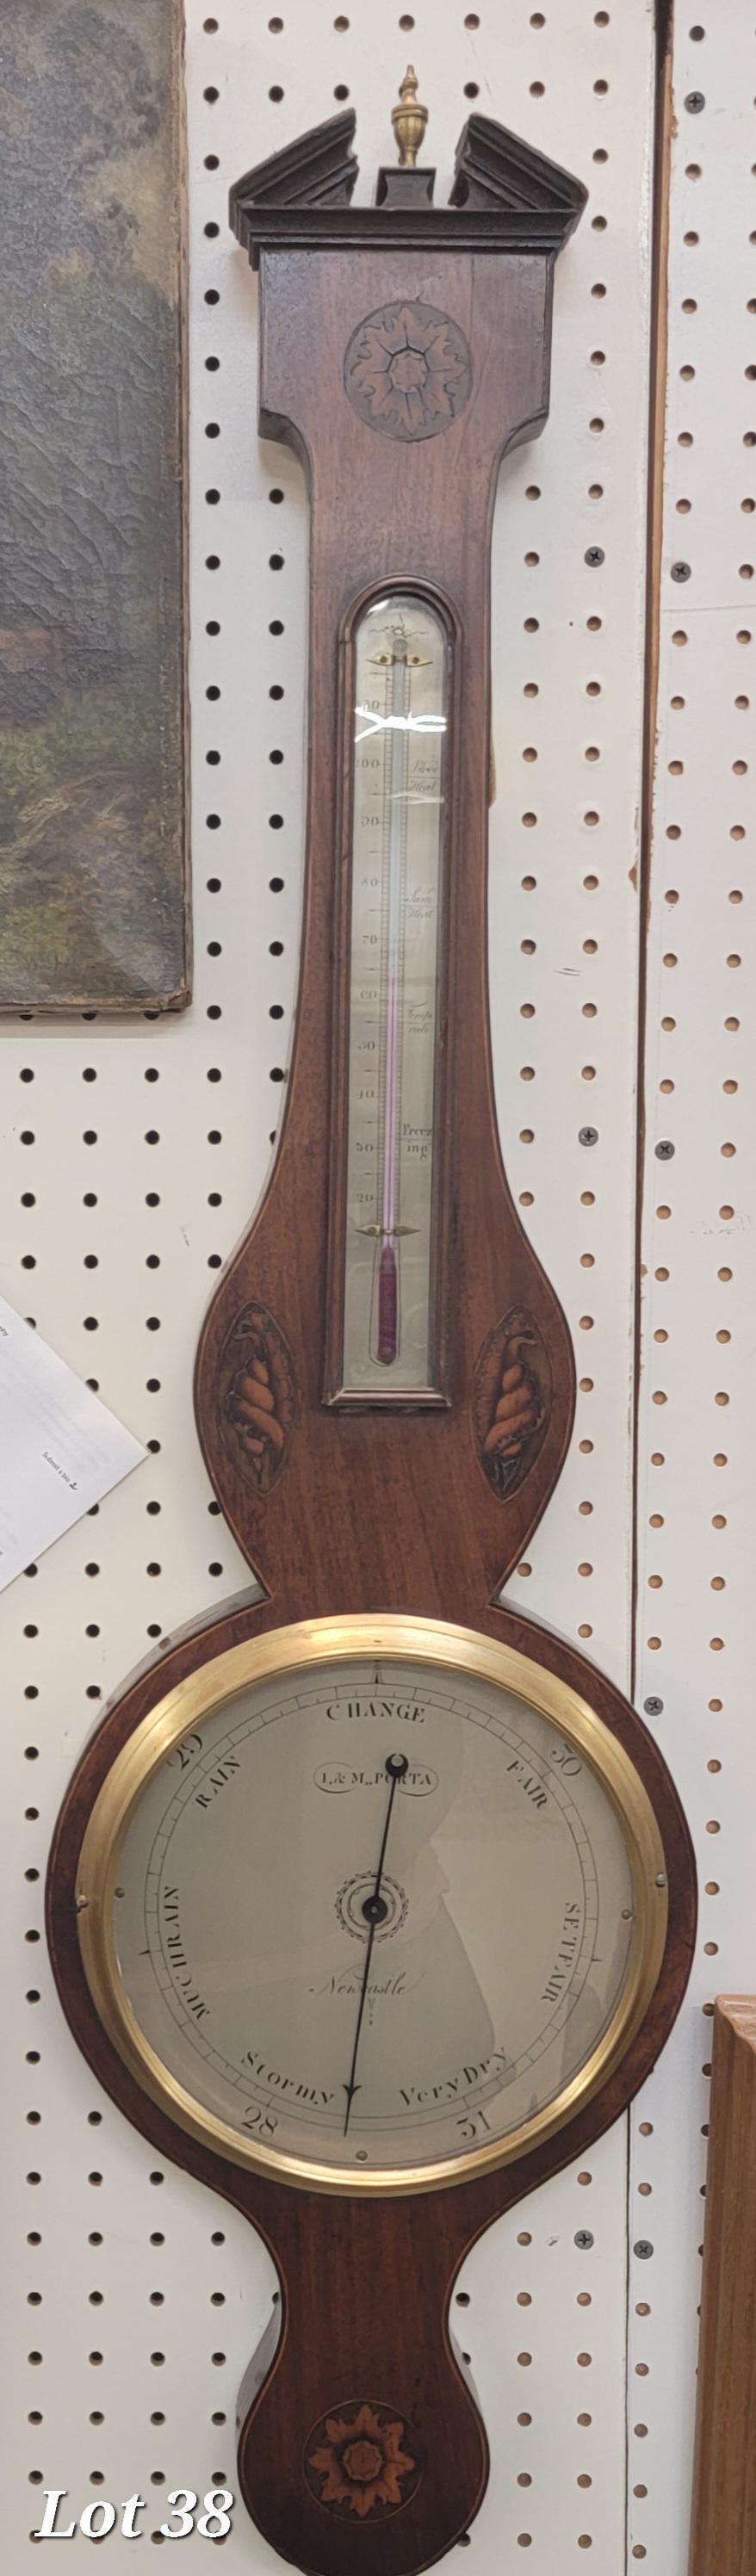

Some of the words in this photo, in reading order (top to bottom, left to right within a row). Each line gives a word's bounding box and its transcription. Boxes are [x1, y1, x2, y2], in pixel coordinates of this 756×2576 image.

[326, 1701, 425, 1724] CHANGE
[166, 1733, 203, 1771] 29
[195, 1755, 241, 1809] RAIN
[506, 1759, 548, 1810] FAIR
[241, 2051, 336, 2106] Stormy
[241, 2106, 279, 2136] 28
